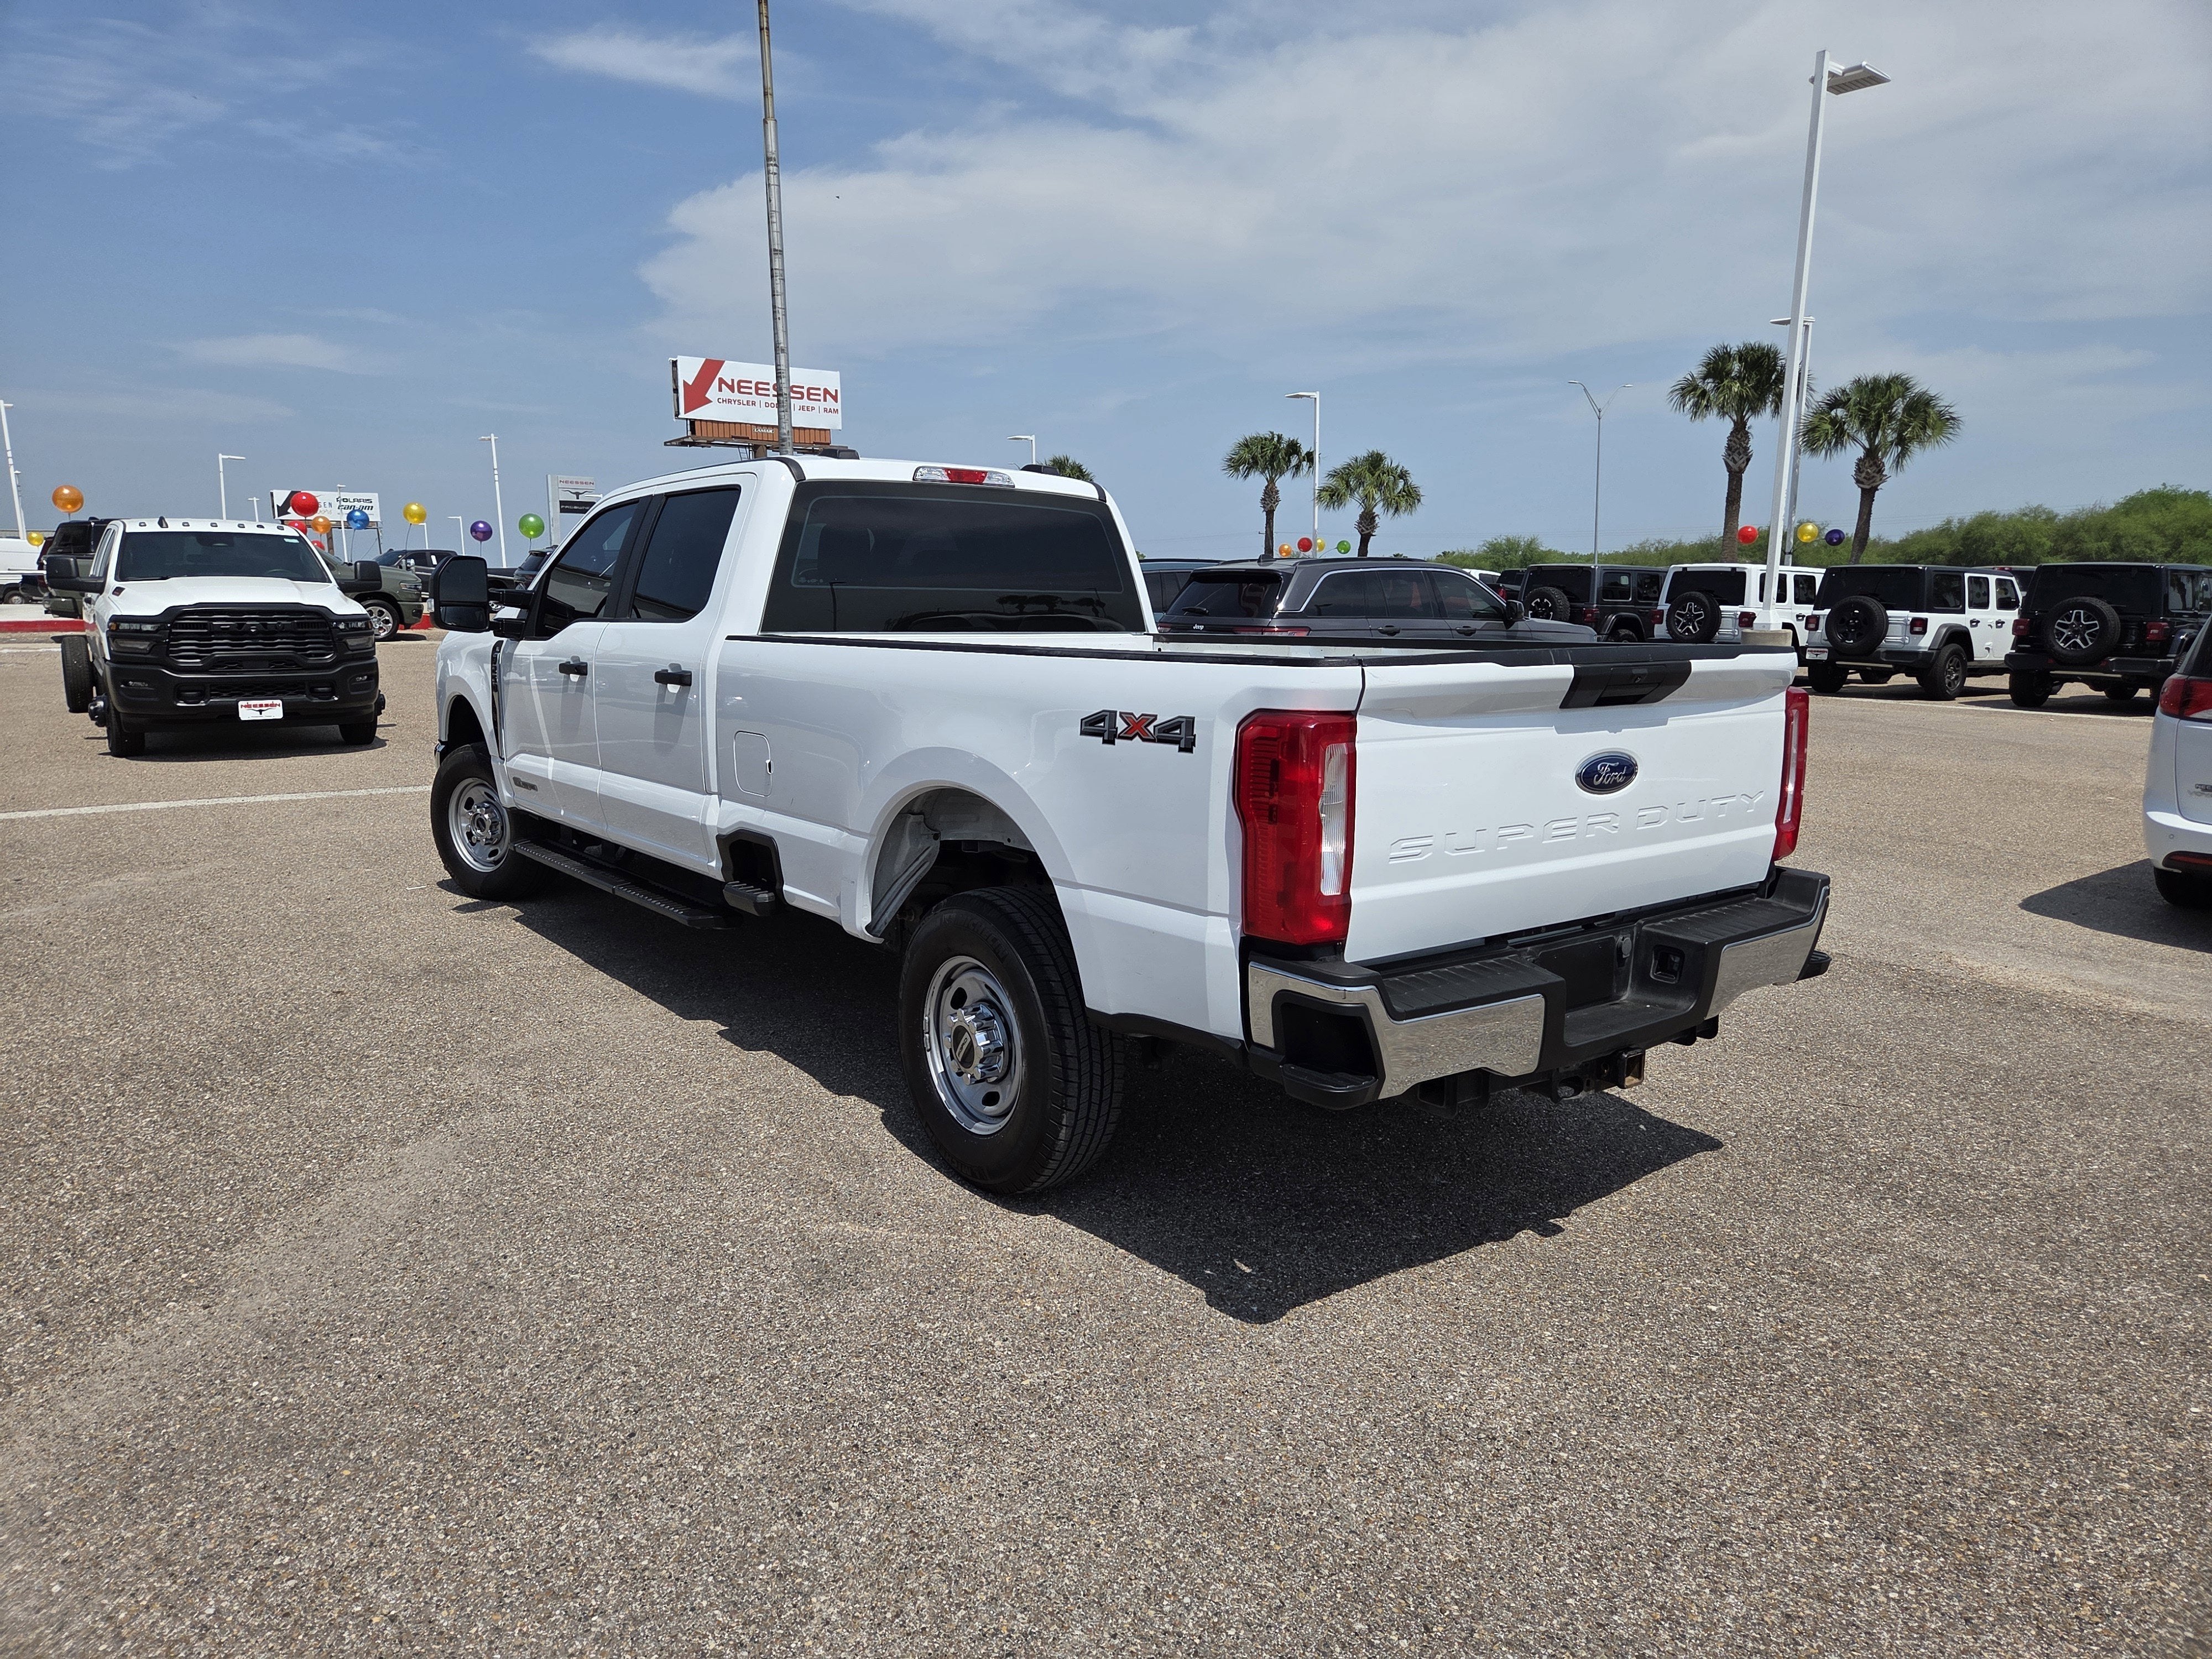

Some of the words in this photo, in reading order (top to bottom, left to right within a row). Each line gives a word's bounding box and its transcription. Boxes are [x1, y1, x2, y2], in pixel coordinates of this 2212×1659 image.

[717, 397, 757, 406] CHRYSLER
[1593, 762, 1627, 785] Ford
[1388, 812, 1620, 864] SUPER
[1636, 790, 1765, 831] DUTY
